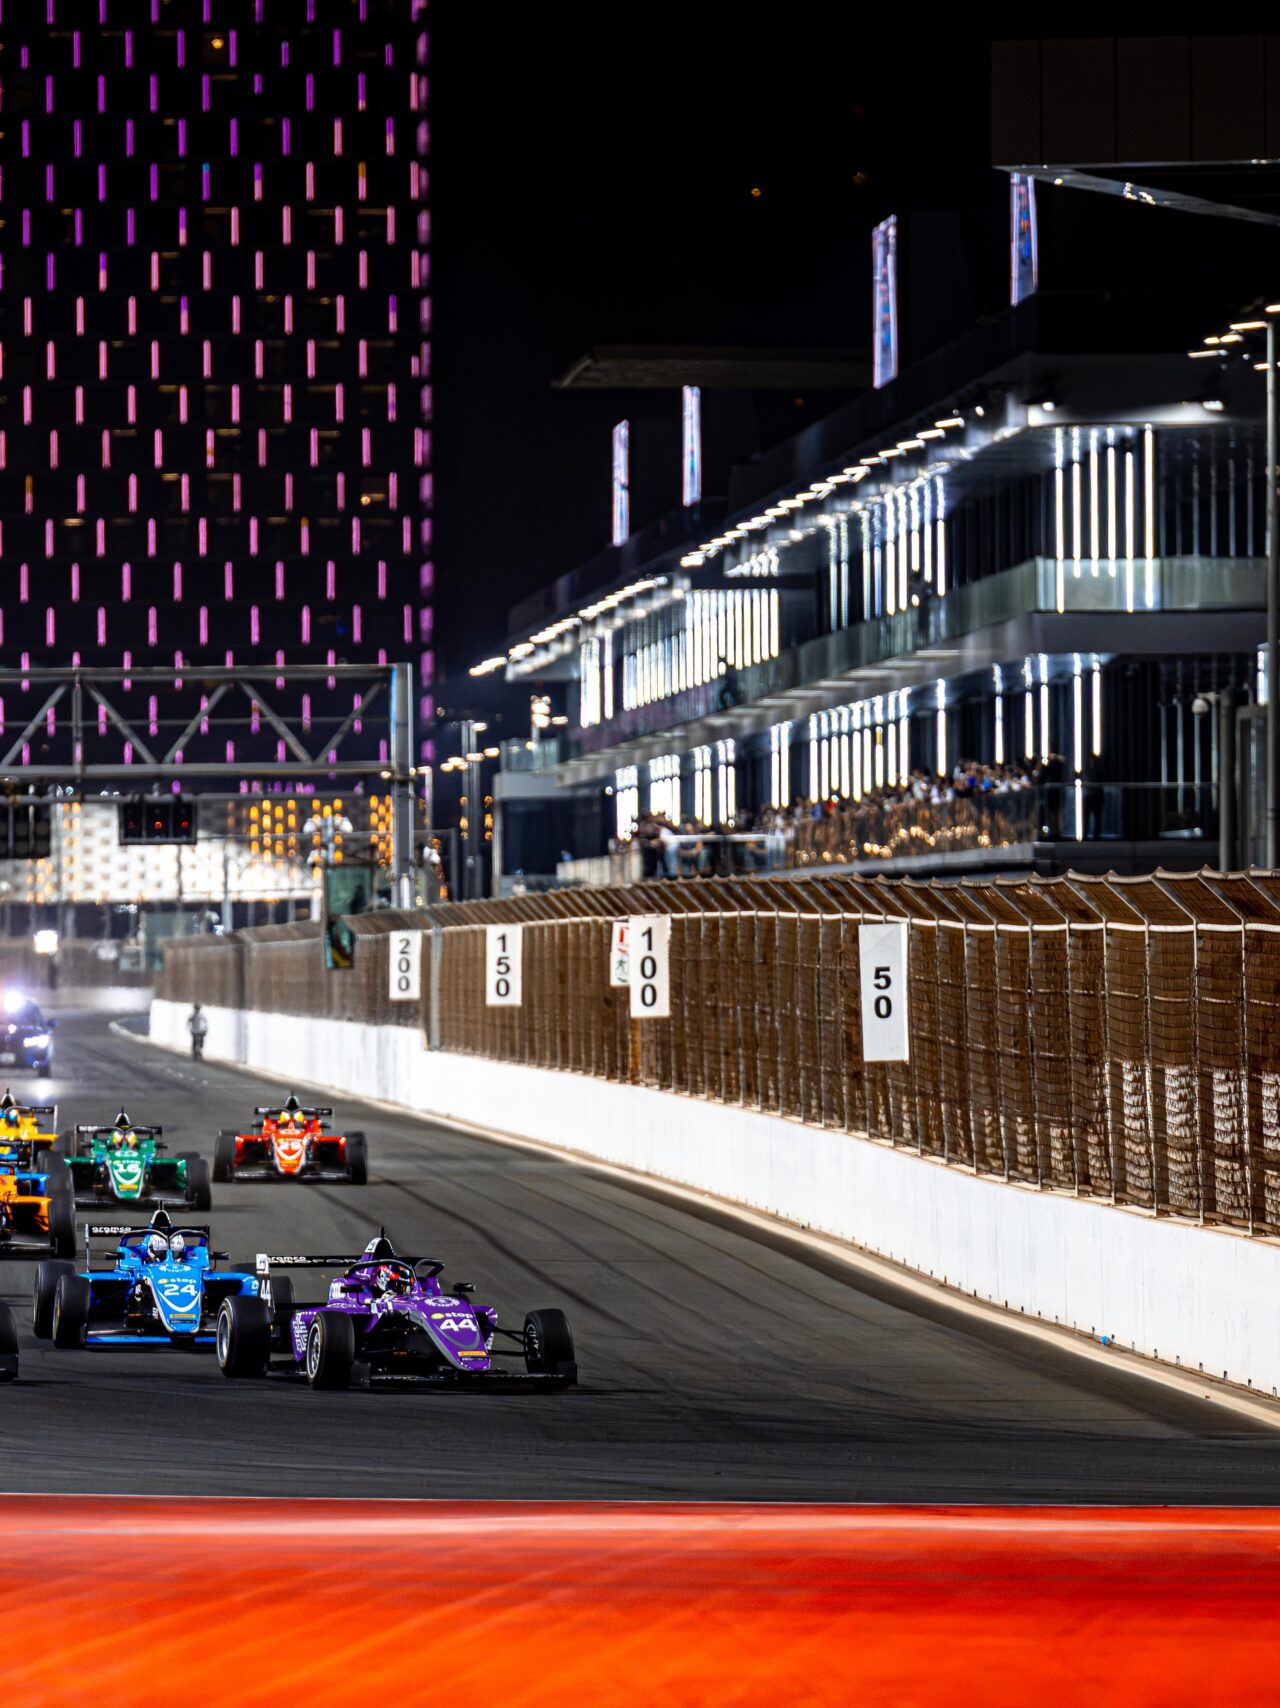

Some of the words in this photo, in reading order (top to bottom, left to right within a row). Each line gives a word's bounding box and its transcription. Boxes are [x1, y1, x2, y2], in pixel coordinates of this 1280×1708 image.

[398, 938, 410, 992] 200
[496, 932, 510, 997] 150
[641, 926, 657, 1007] 100
[873, 966, 892, 1019] 50
[163, 1283, 198, 1297] 24
[444, 1311, 474, 1319] stop
[440, 1318, 478, 1332] 44
